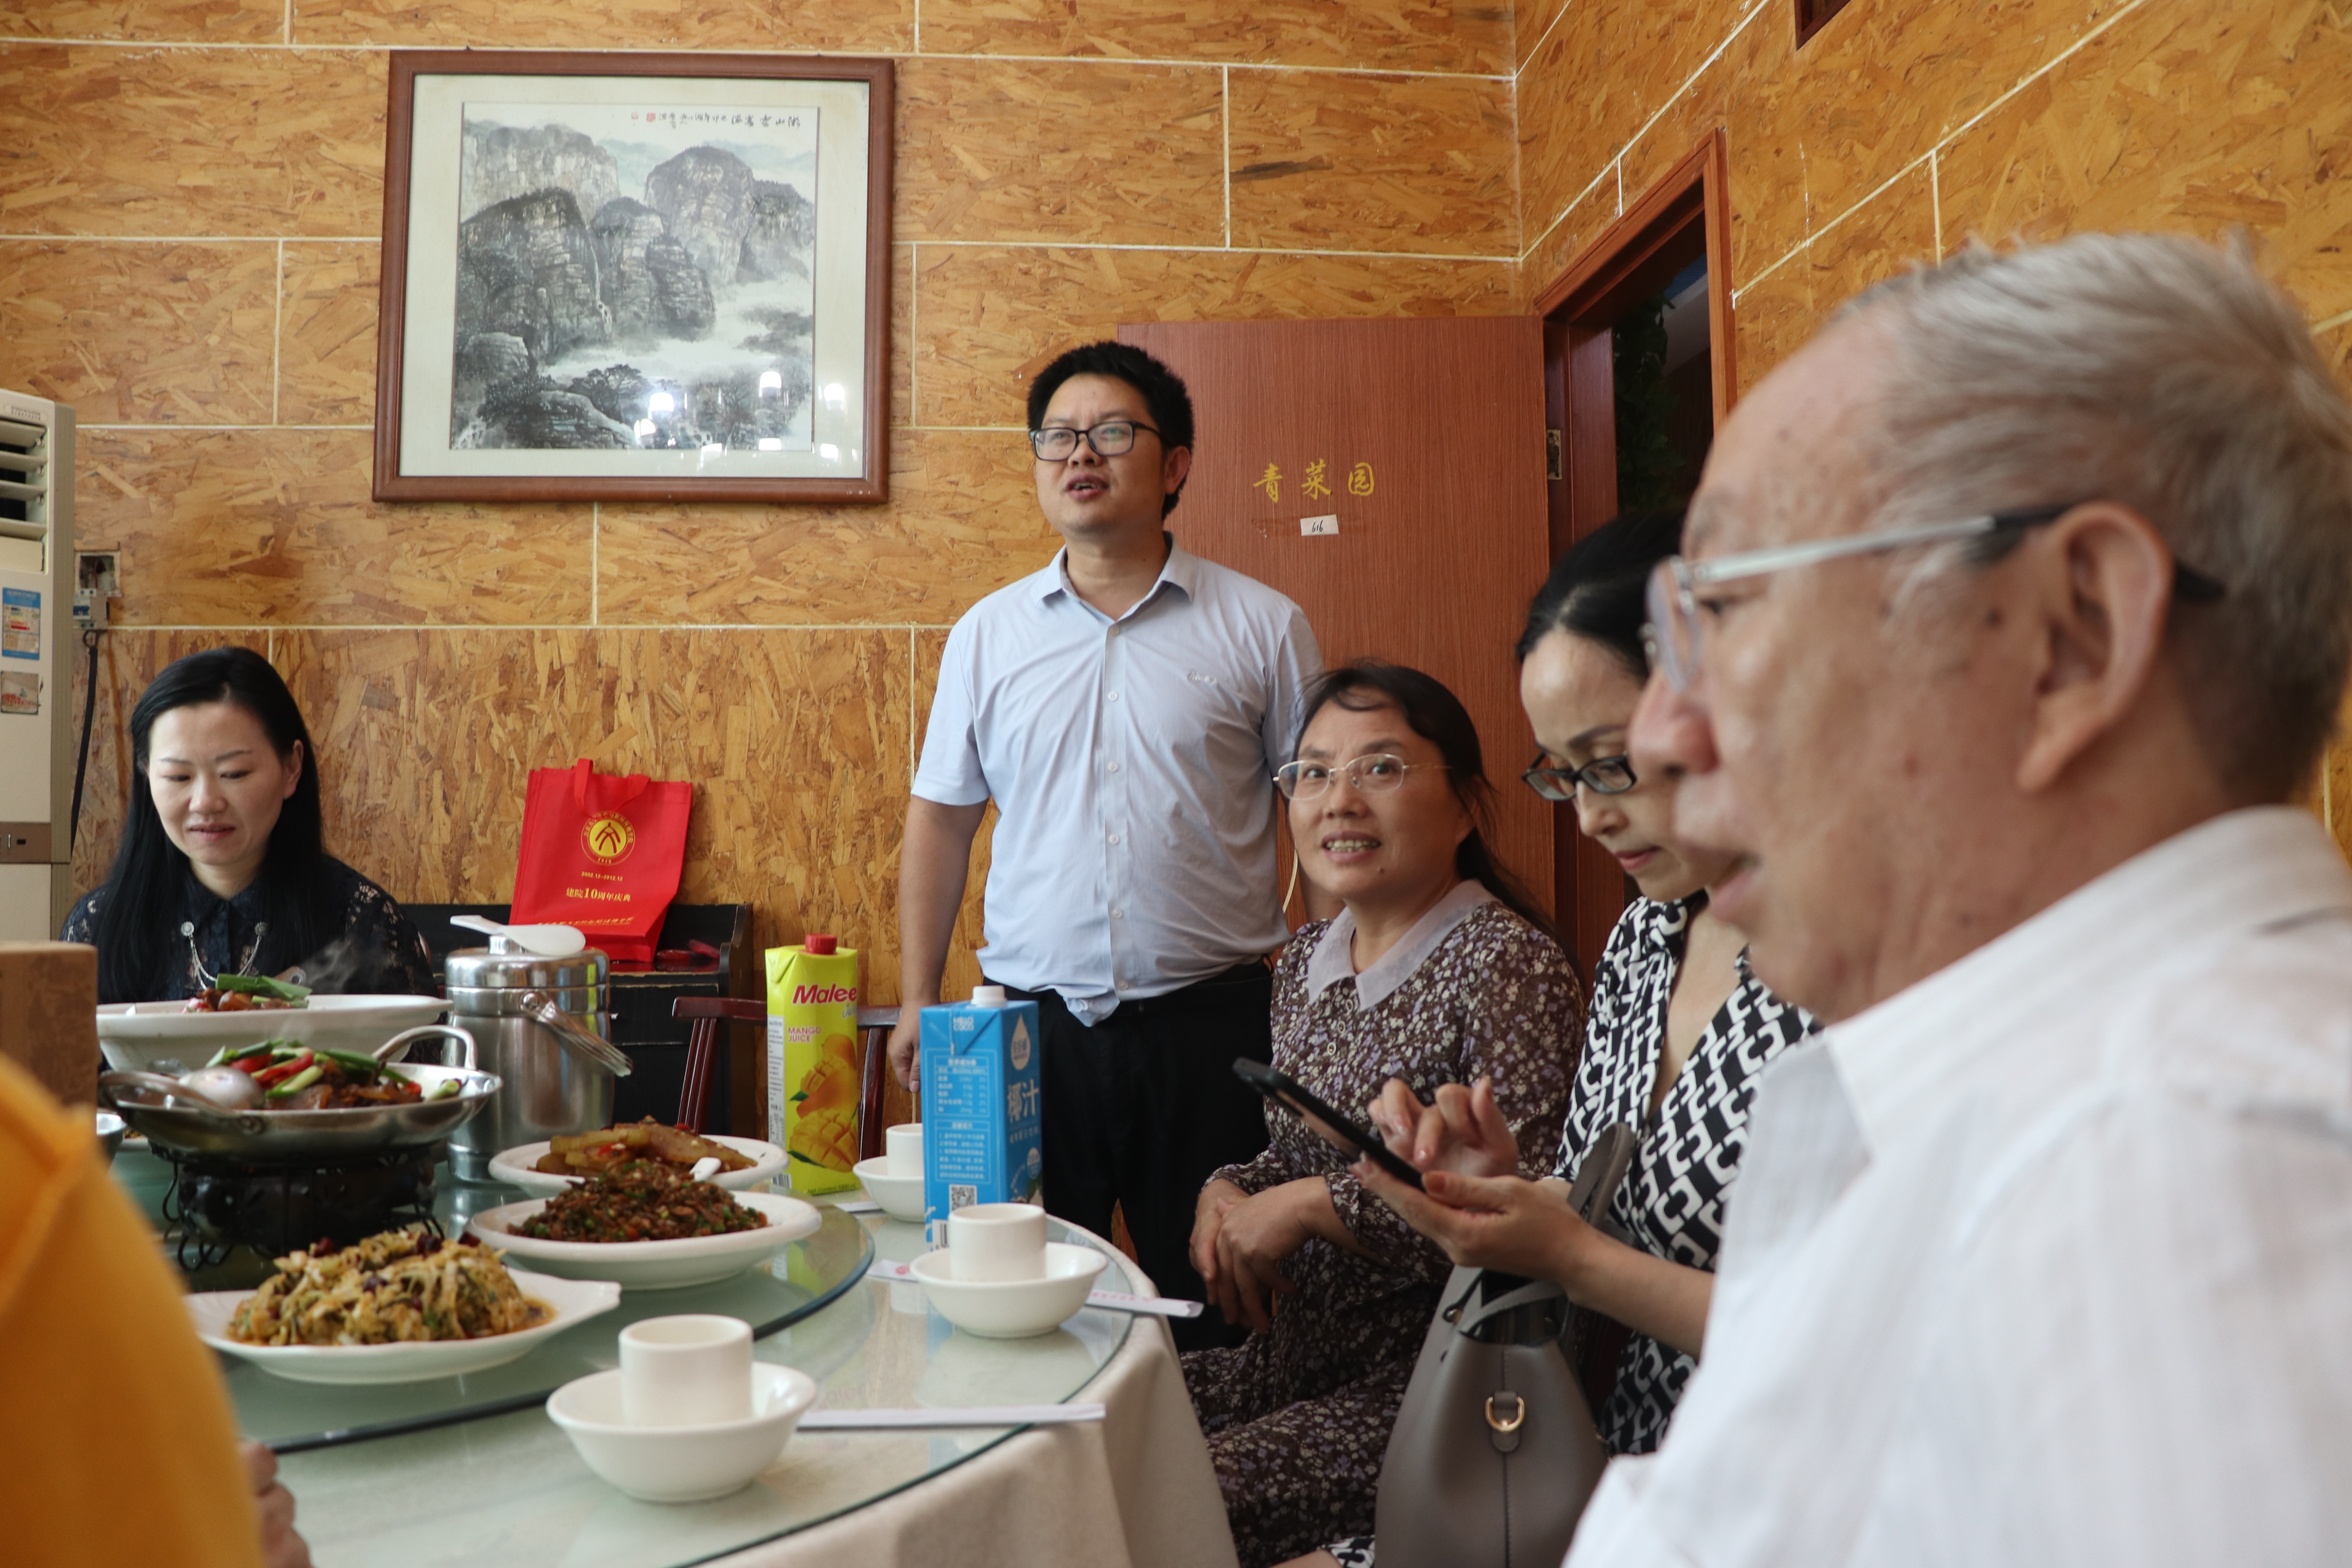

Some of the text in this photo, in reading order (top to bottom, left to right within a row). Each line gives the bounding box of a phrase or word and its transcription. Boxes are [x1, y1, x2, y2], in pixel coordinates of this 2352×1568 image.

[1252, 458, 1375, 503] 青菜园
[1311, 519, 1324, 533] 616
[566, 887, 631, 902] 建院10周年庆典
[793, 983, 857, 1004] Malee
[788, 1026, 822, 1035] MANGO
[1007, 1078, 1040, 1124] 椰汁
